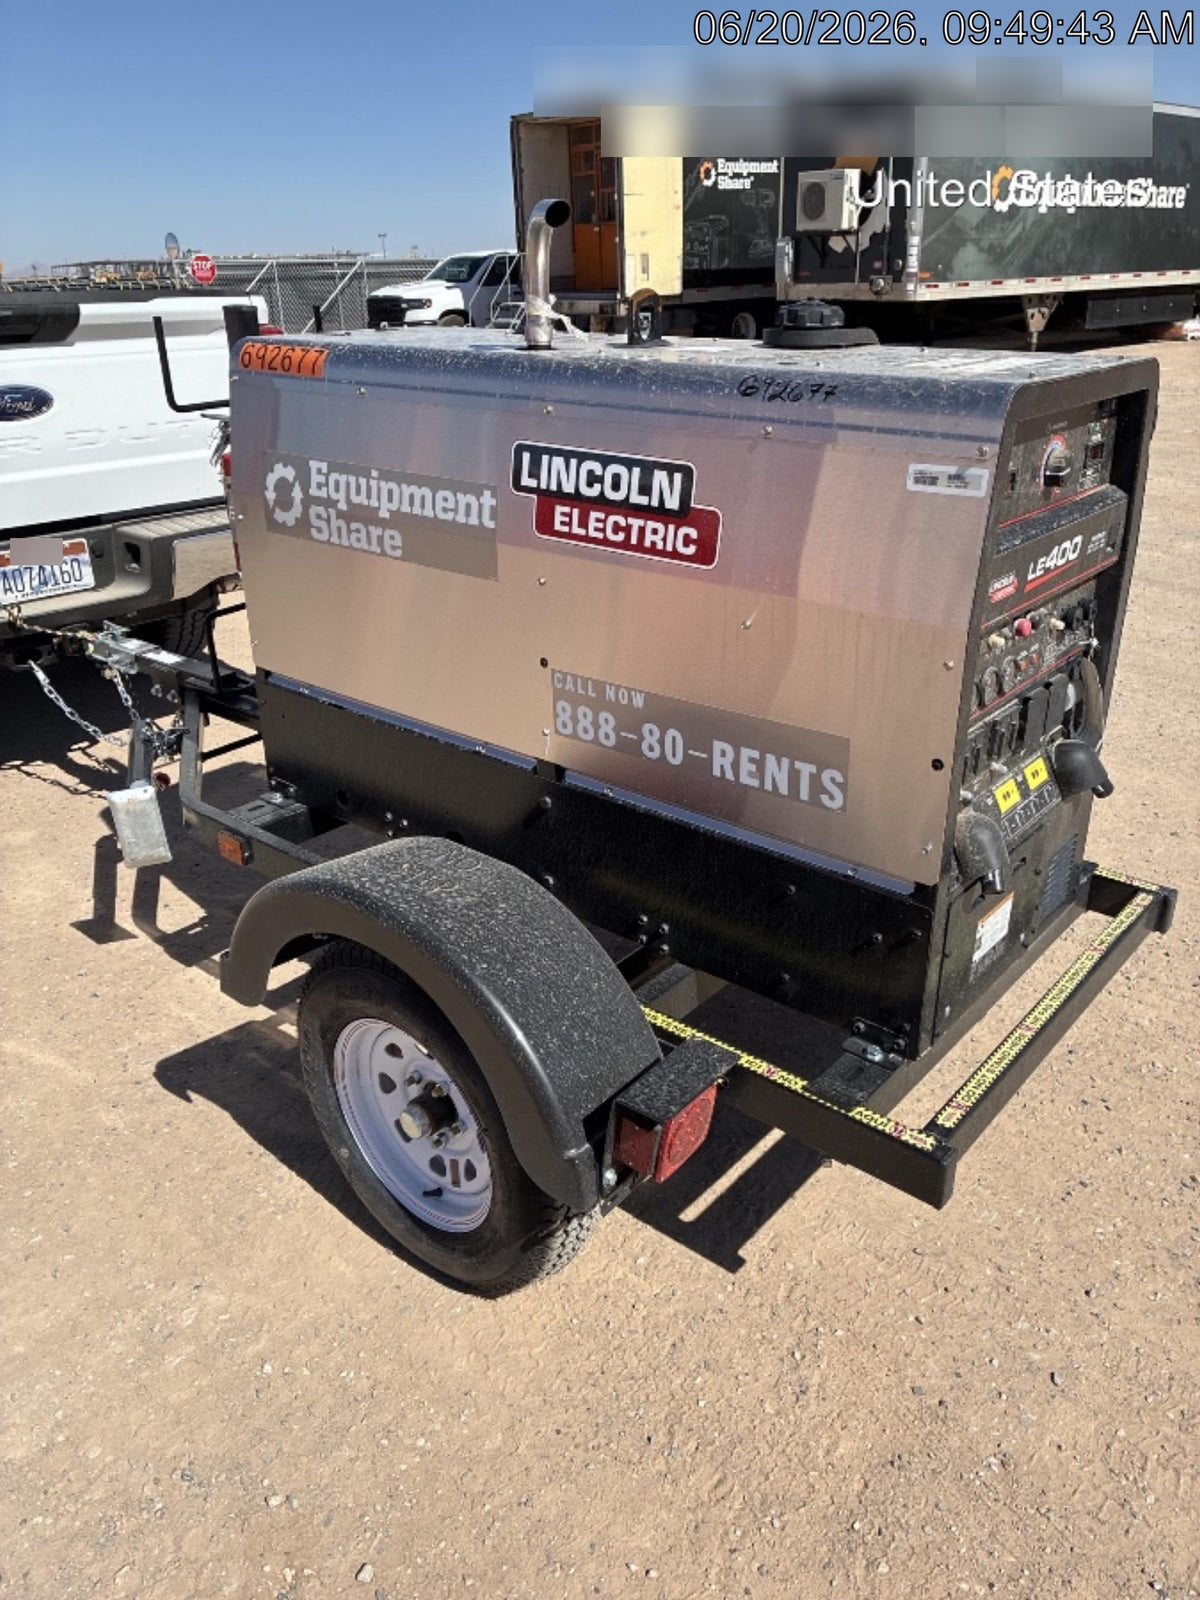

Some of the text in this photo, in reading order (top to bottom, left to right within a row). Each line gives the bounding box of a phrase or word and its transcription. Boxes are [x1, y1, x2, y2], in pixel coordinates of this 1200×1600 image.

[716, 158, 779, 176] Equipment
[717, 176, 752, 189] Share
[241, 344, 325, 375] 692677
[738, 374, 838, 402] 692677
[308, 459, 497, 529] Equipment
[520, 450, 683, 511] LINCOLN
[308, 504, 403, 558] Share
[553, 504, 698, 556] ELECTRIC
[1026, 533, 1084, 581] LE400
[552, 671, 646, 709] CALL NOW
[554, 699, 845, 811] 888-80-RENTS
